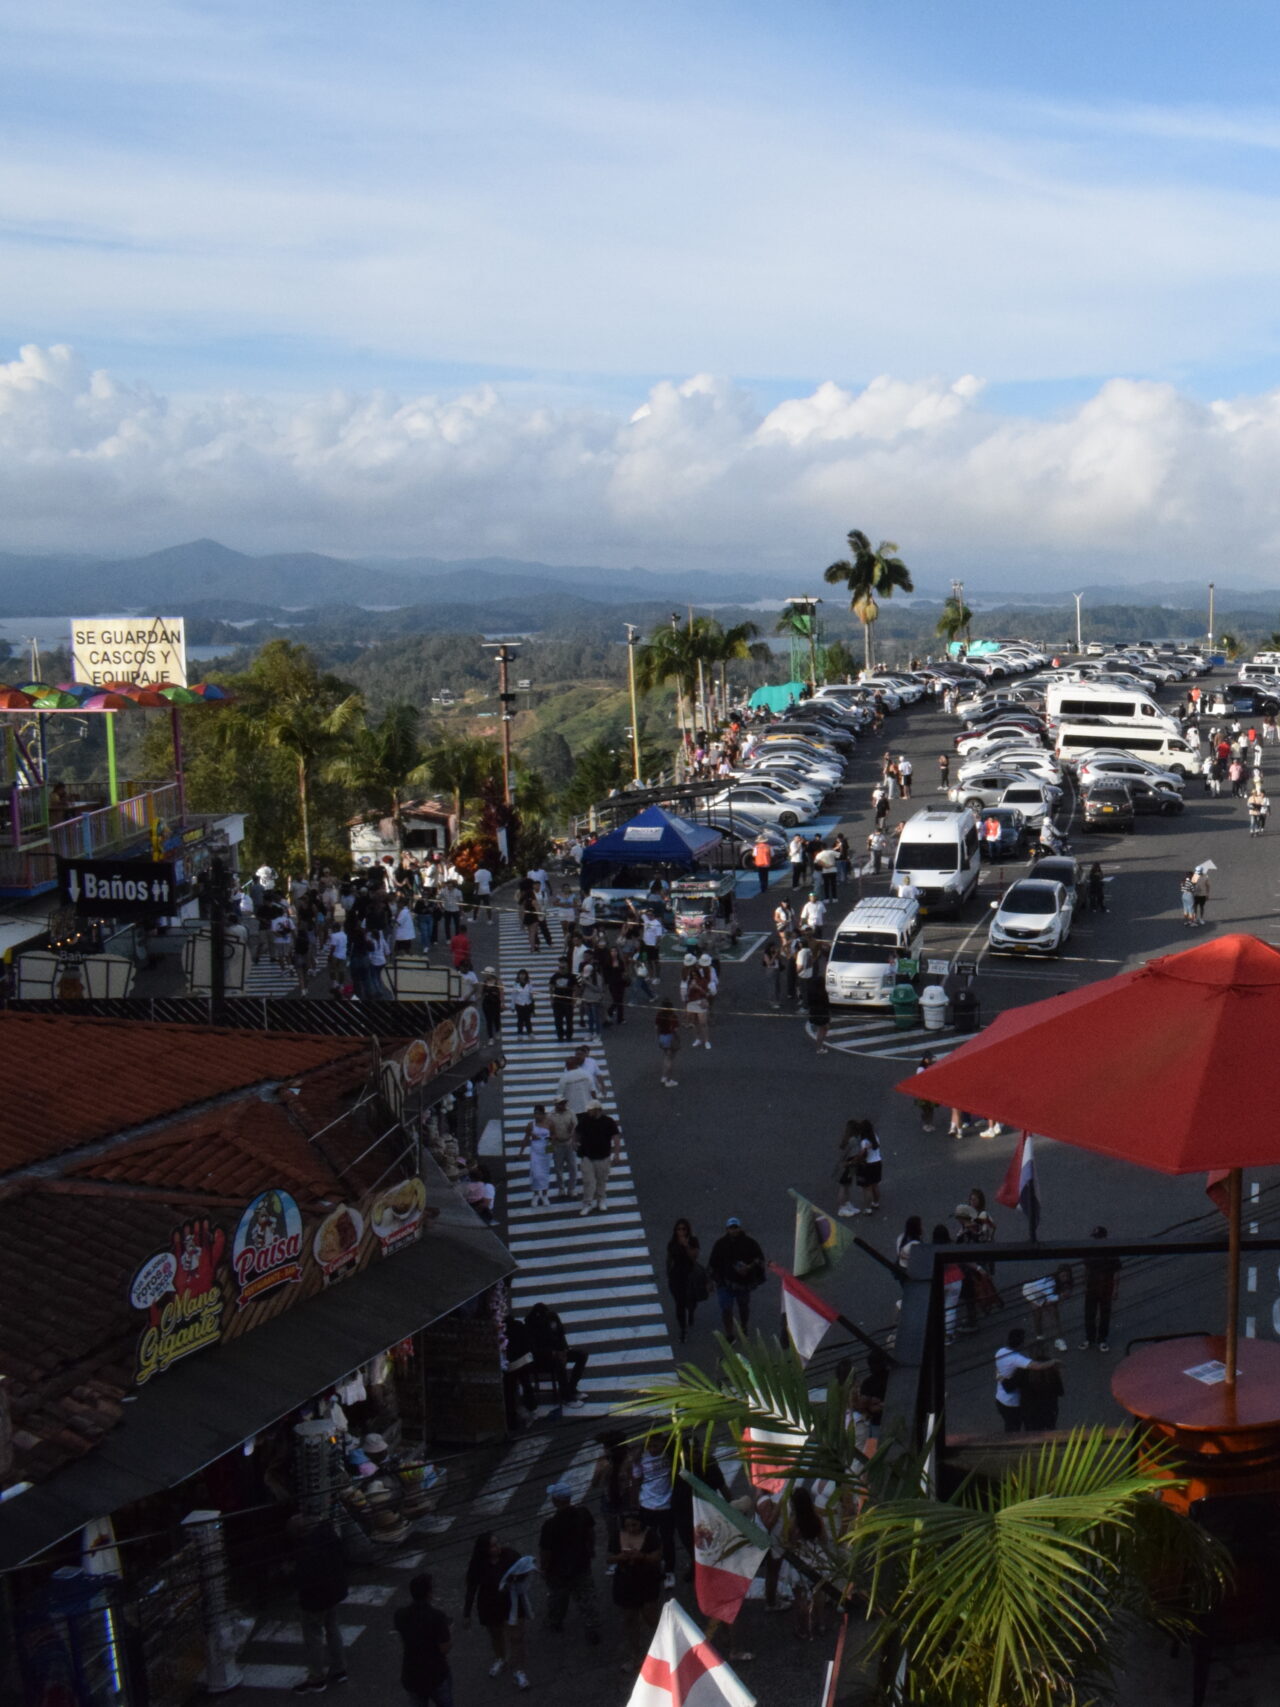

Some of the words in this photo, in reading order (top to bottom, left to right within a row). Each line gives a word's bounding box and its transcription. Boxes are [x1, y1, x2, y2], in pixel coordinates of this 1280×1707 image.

[76, 631, 96, 645] SE
[101, 630, 181, 645] GUARDAN
[89, 650, 156, 665] CASCOS
[161, 650, 171, 664] Y
[92, 670, 171, 685] EQUIPAJE
[84, 873, 149, 900] Baños
[235, 1233, 301, 1285] Paisa
[161, 1286, 221, 1334] Mano
[137, 1314, 220, 1382] Gigante
